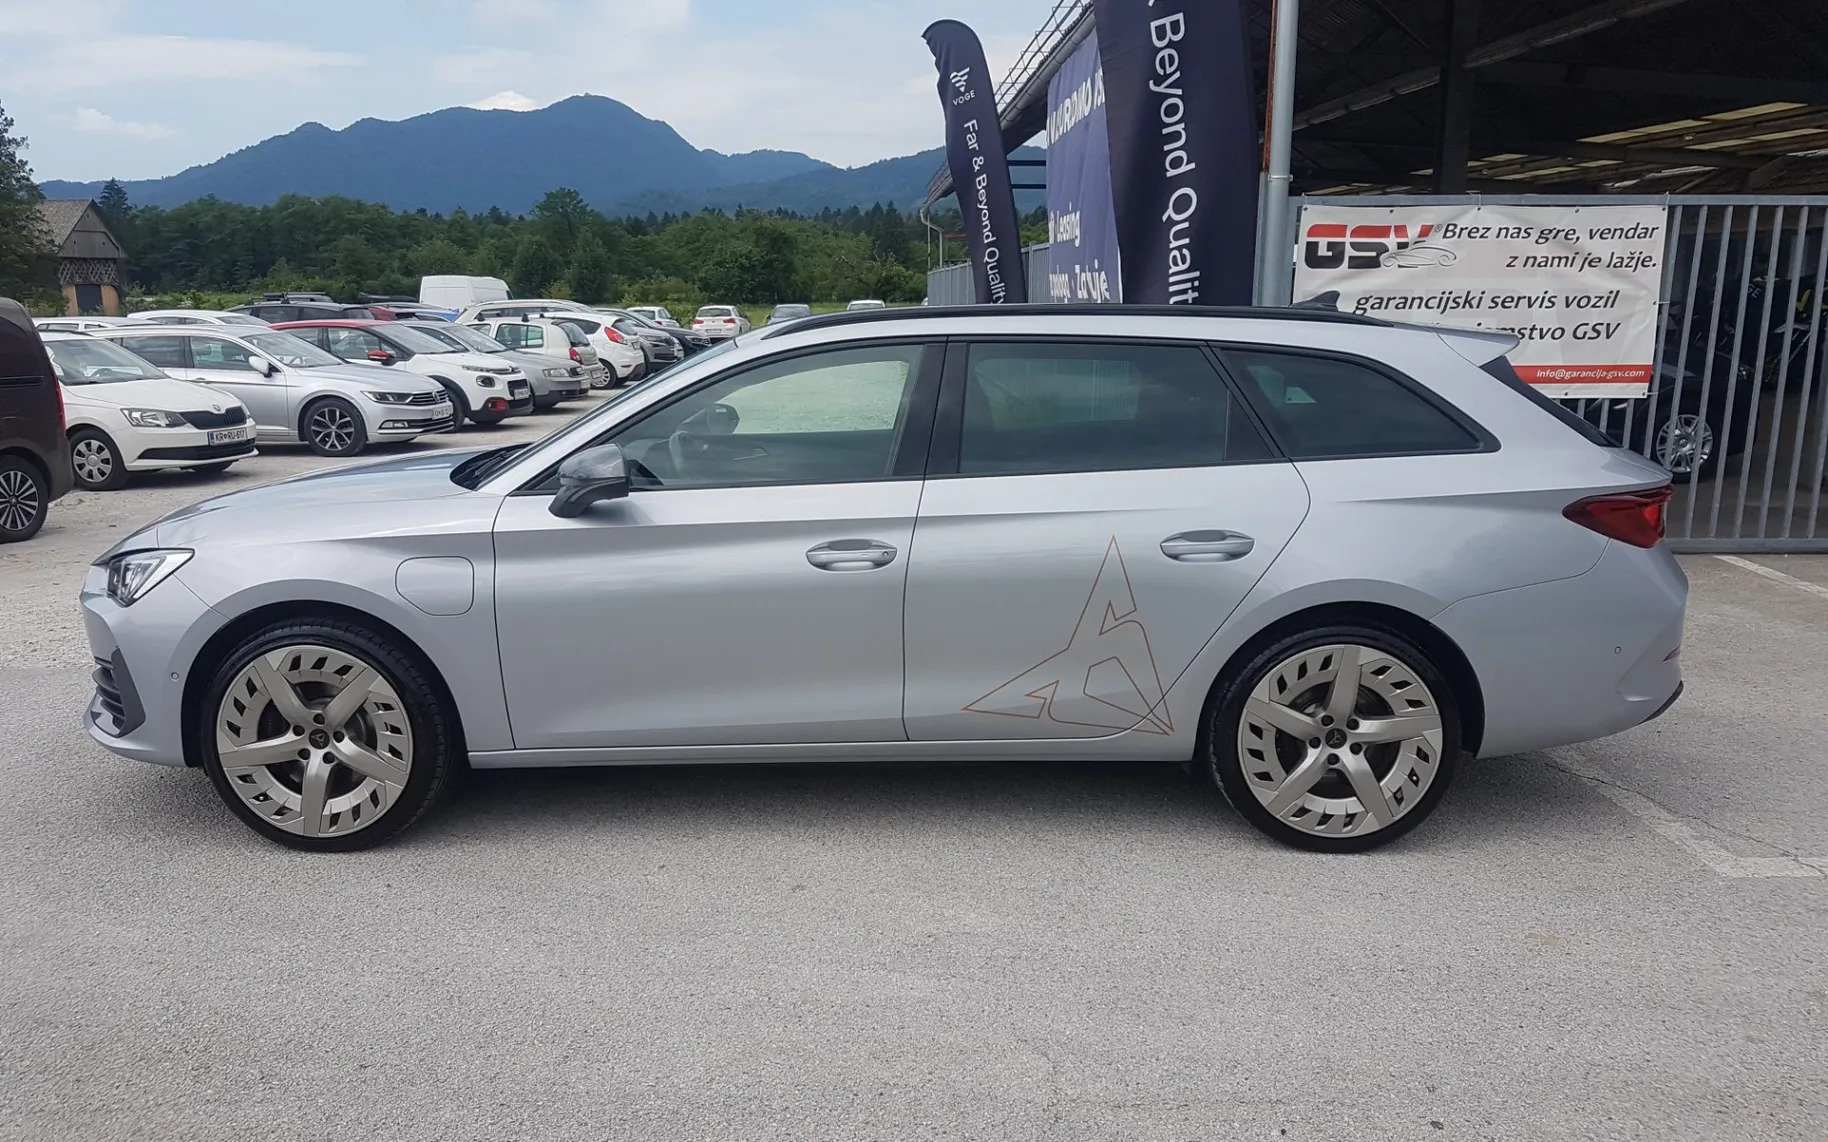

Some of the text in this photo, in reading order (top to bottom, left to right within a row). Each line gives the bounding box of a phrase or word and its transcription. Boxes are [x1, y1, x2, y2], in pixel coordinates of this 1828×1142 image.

[952, 90, 976, 106] VOGE
[963, 119, 979, 151] Far
[972, 156, 985, 172] &
[1149, 11, 1201, 304] Beyond Qualit
[975, 173, 997, 244] Beyond
[1442, 222, 1660, 245] Brez nas gre, vendar
[1304, 223, 1435, 270] GSV
[1505, 251, 1658, 273] z nami je lažje.
[1353, 290, 1621, 315] garancijski servis vozil
[1571, 322, 1622, 341] GSV
[1536, 368, 1645, 380] info@garancija-gsv.com
